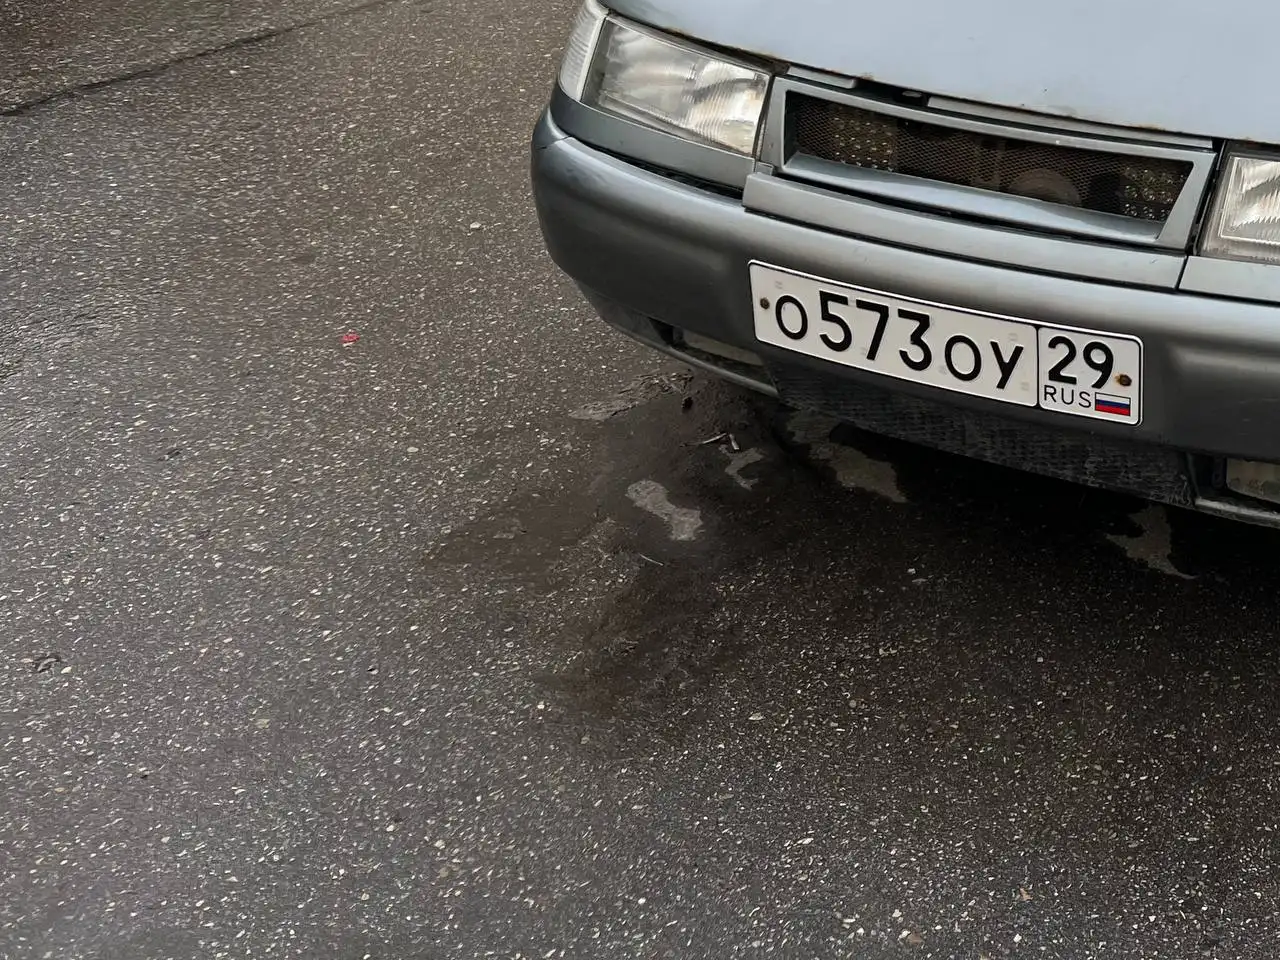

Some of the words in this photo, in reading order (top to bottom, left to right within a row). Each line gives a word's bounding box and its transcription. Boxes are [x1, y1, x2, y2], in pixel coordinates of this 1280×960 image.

[774, 290, 1024, 390] О573ОУ
[1046, 335, 1115, 389] 29
[1043, 385, 1092, 409] RUS
